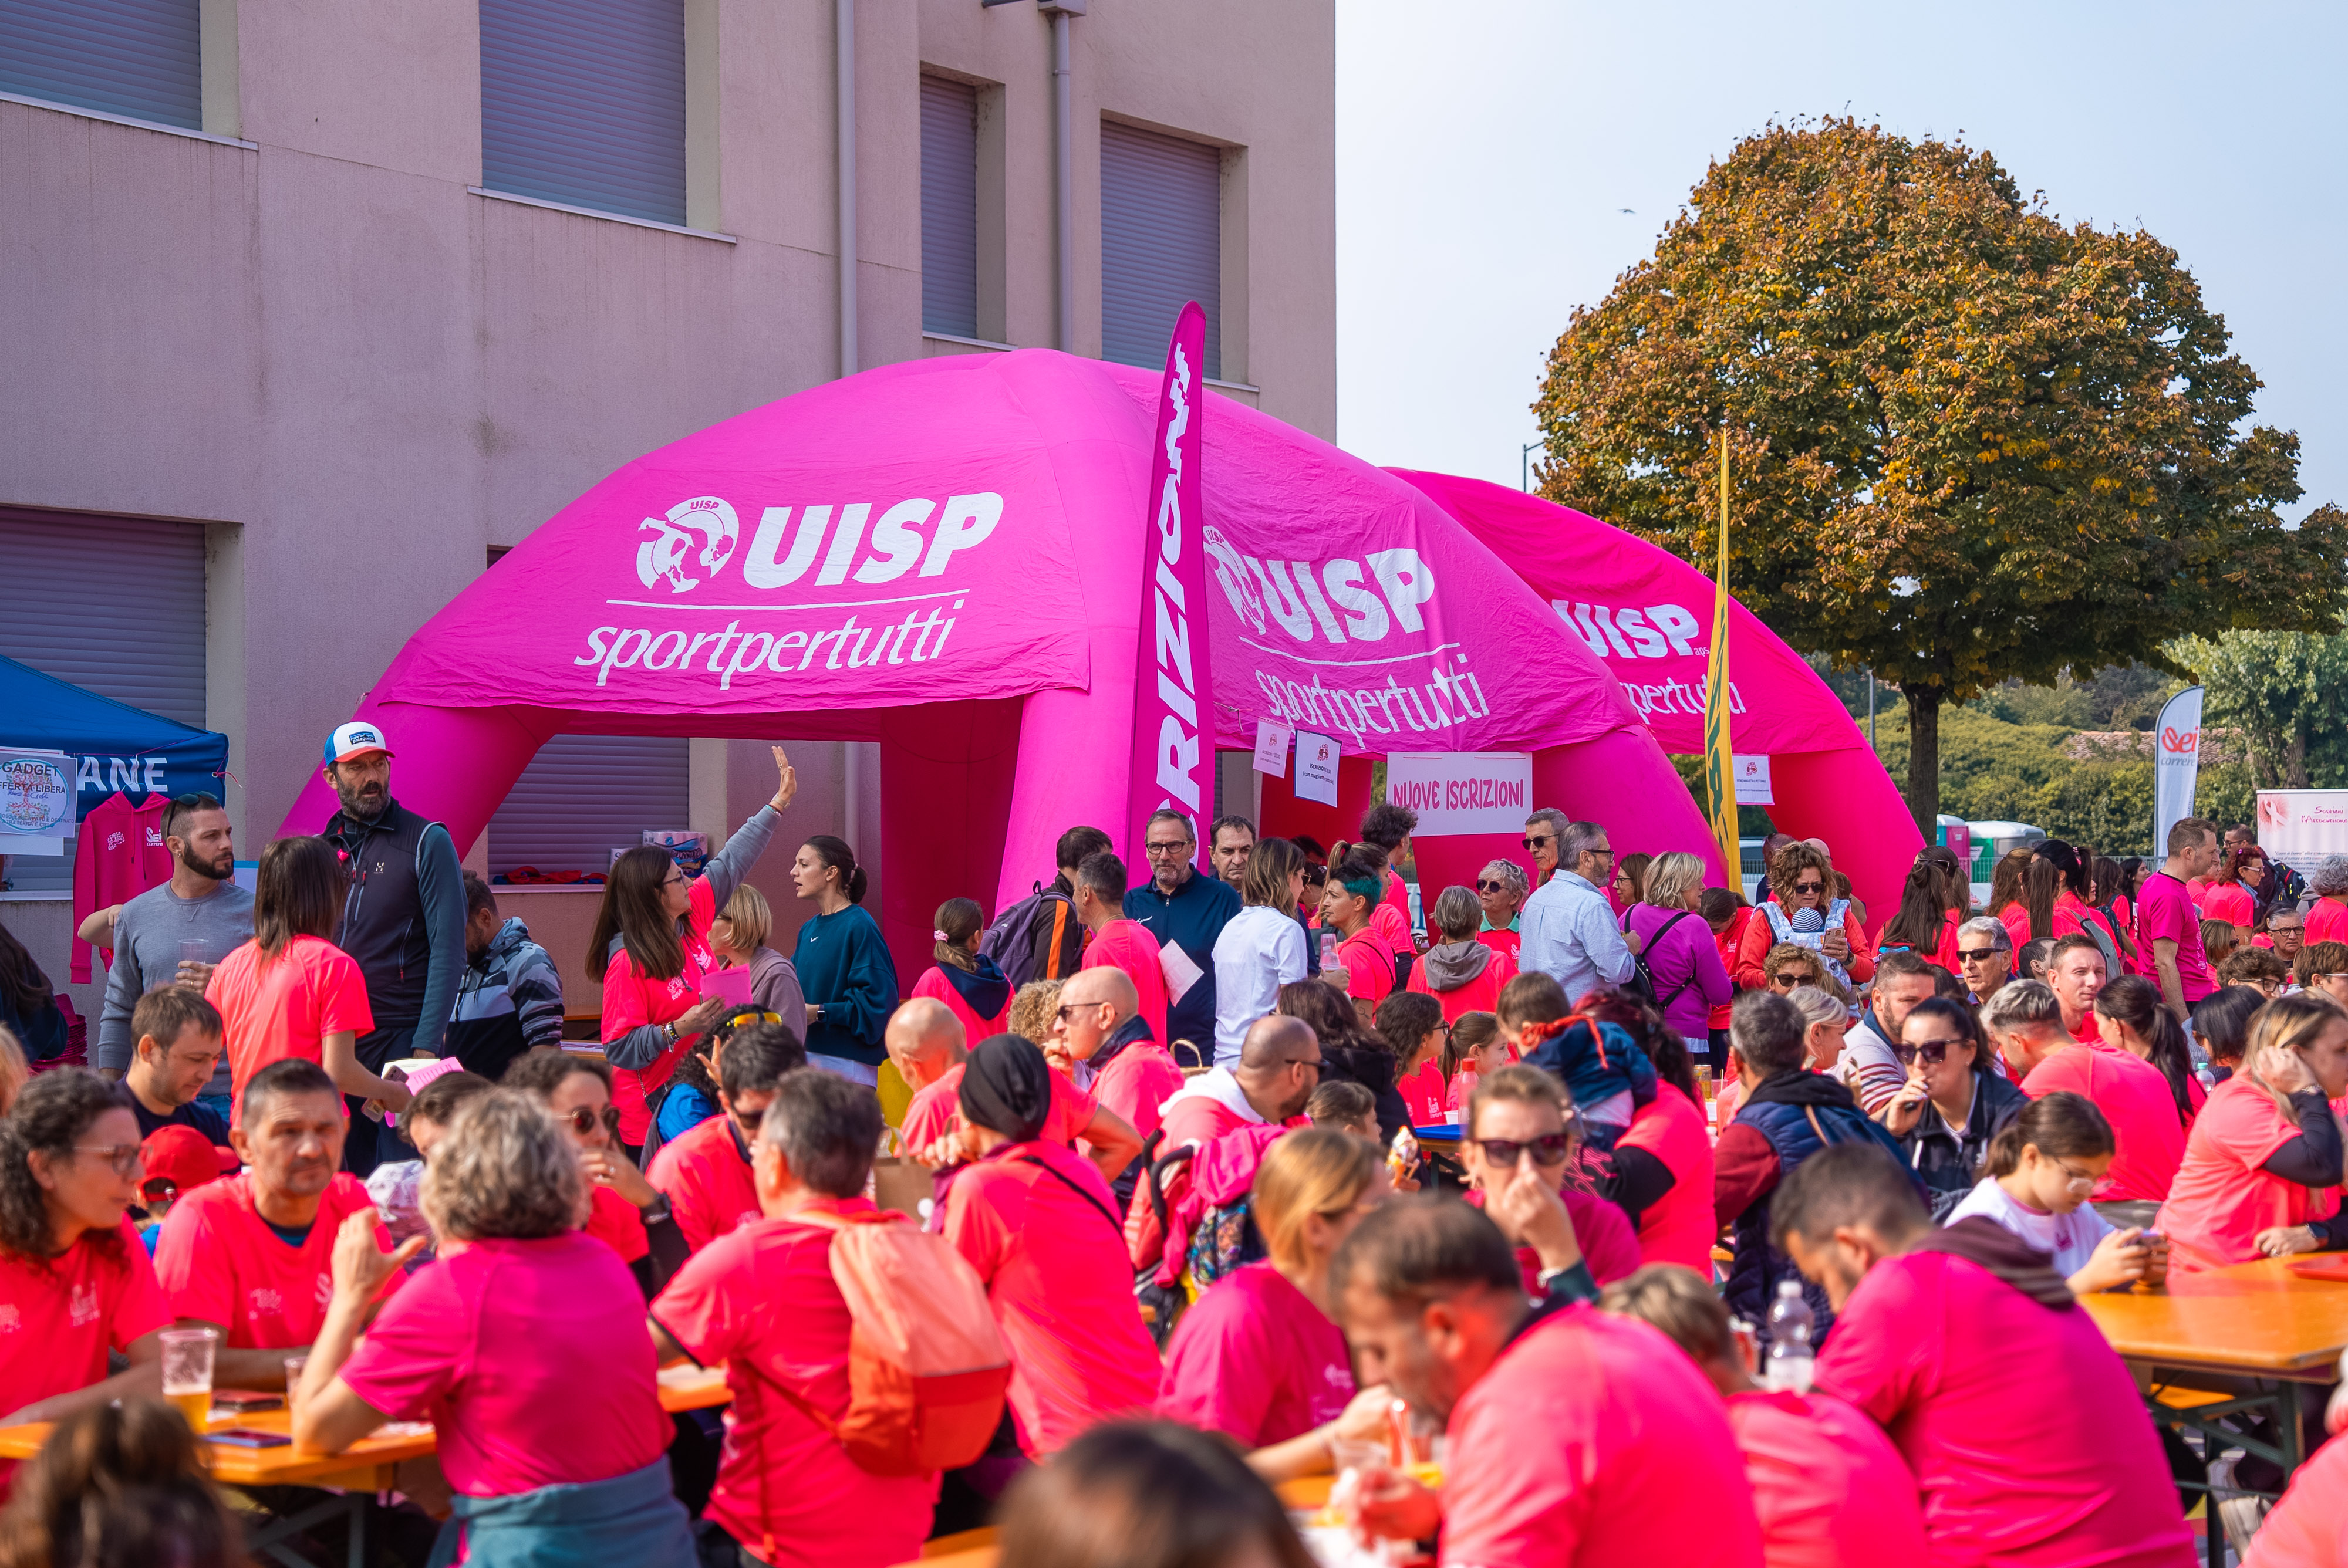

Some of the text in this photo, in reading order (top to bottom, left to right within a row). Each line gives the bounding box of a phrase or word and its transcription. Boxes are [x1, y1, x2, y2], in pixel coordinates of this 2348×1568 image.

[690, 500, 719, 509] UISP
[742, 492, 1004, 589] UISP
[1242, 548, 1435, 643] UISP
[573, 599, 965, 691] sportpertutti
[1551, 599, 1710, 658] UISP aps
[1256, 653, 1490, 749] sportpertutti
[2161, 726, 2199, 753] Sei
[2, 762, 59, 776] GADGET
[2161, 755, 2196, 766] correre
[36, 785, 66, 794] LIBERA
[1394, 778, 1524, 811] NUOVE ISCRIZIONI
